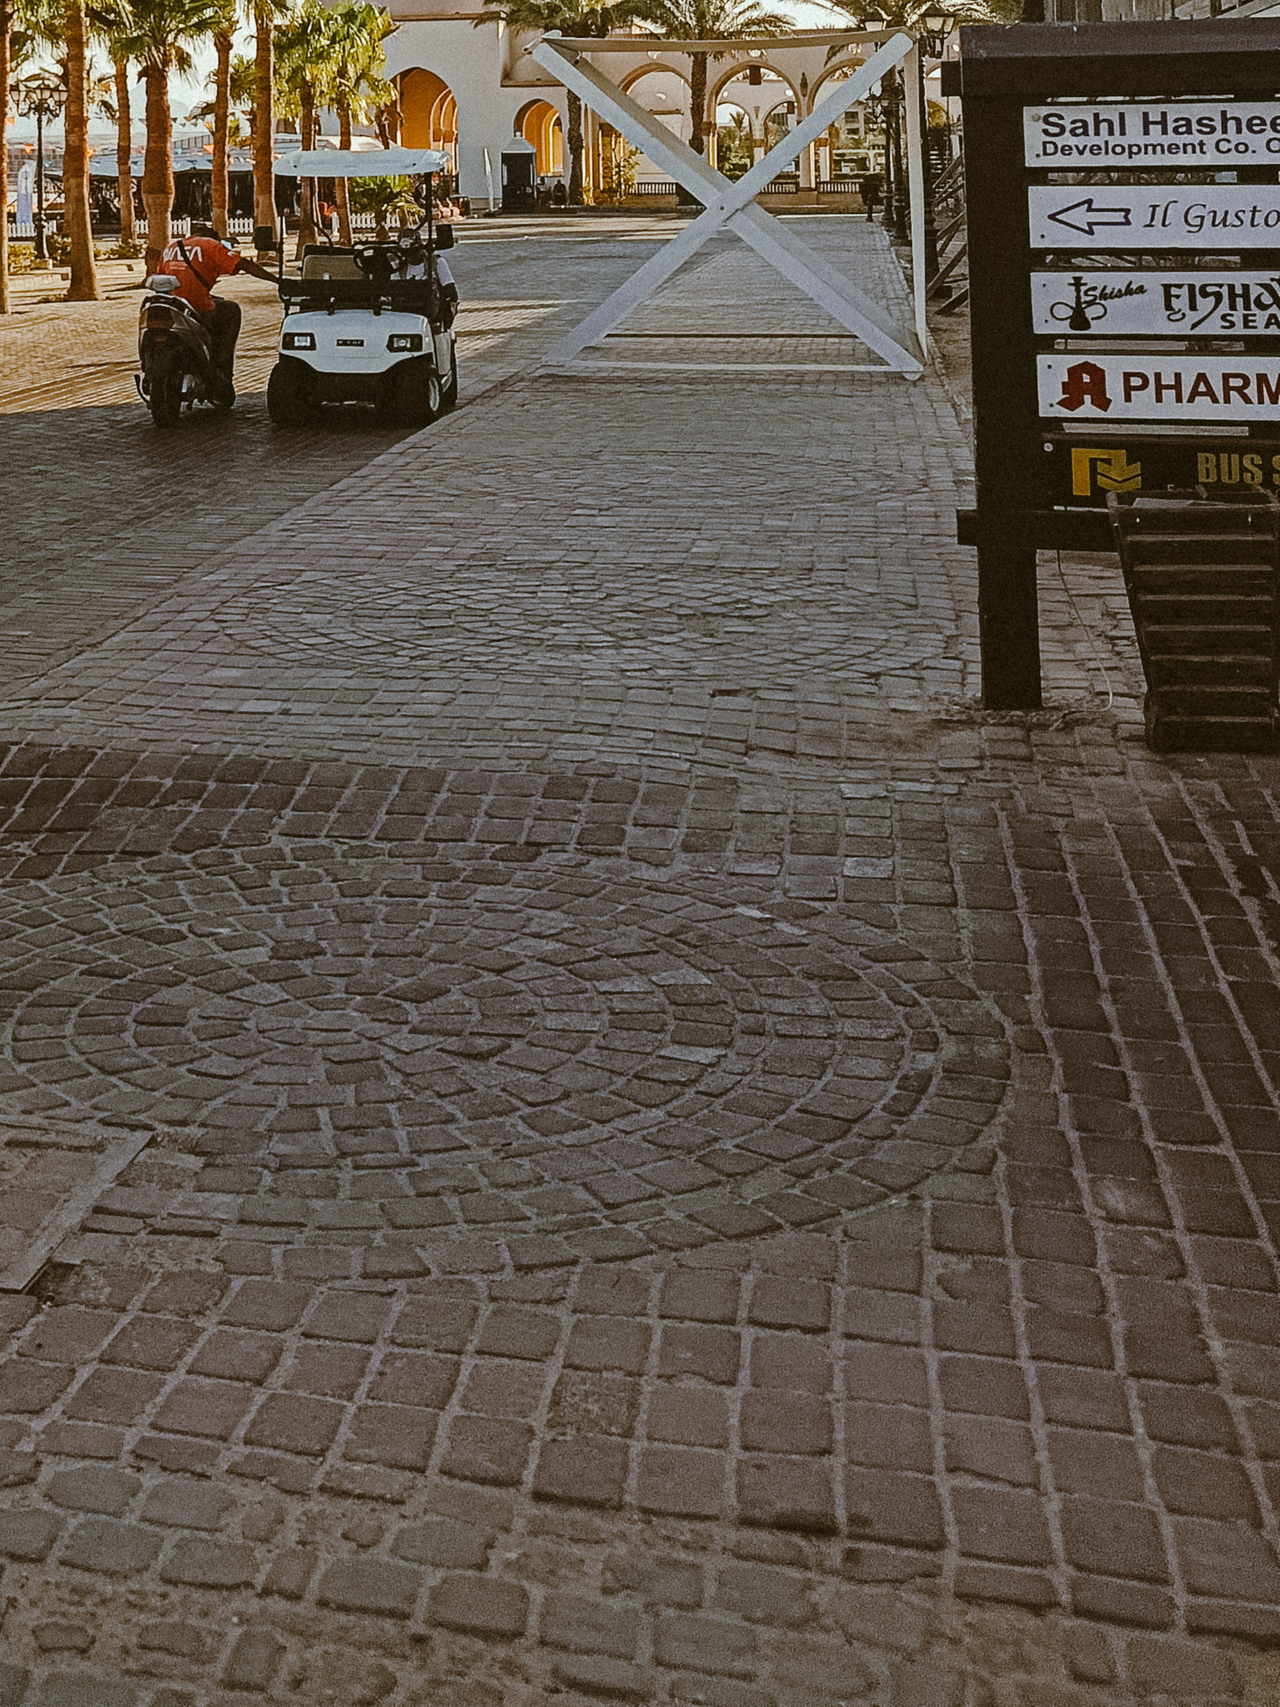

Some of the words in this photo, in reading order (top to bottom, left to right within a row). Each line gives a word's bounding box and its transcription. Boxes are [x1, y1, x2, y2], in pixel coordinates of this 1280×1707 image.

[1041, 111, 1127, 138] Sahl
[1042, 139, 1208, 159] Development
[1215, 137, 1257, 154] Co.
[1143, 200, 1178, 228] Il
[1183, 203, 1280, 234] Gusto
[1082, 280, 1148, 304] Shisha
[1220, 312, 1280, 330] SEA
[1122, 371, 1280, 405] PHARM
[1198, 453, 1263, 484] BUS
